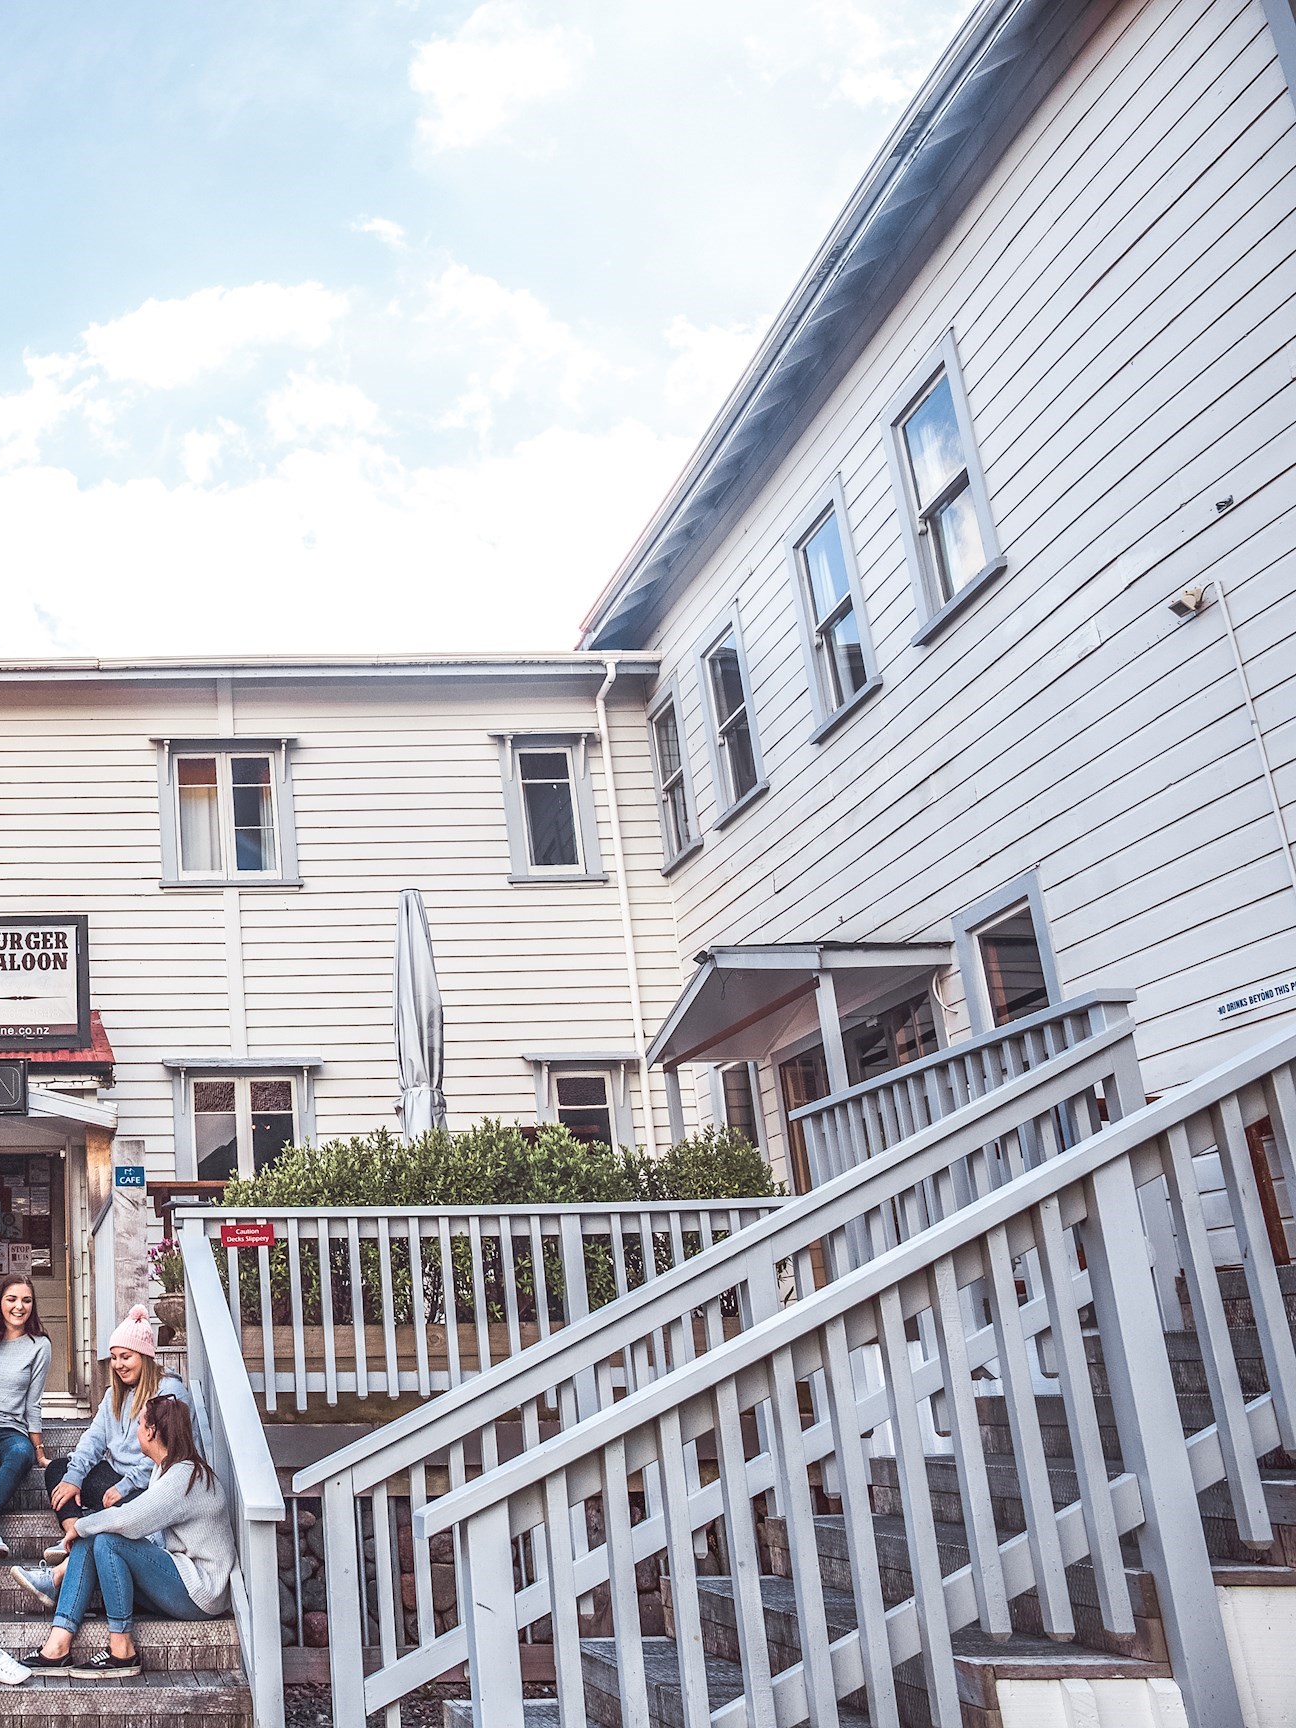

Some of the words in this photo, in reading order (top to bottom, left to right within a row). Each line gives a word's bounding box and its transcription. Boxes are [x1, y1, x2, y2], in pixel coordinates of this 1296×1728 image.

[1217, 1005, 1226, 1015] NO
[1226, 998, 1248, 1012] DRINKS
[1248, 989, 1274, 1005] BEYOND
[1274, 983, 1290, 996] THIS
[119, 1176, 141, 1184] CAFE
[245, 1235, 270, 1243] Slippery
[11, 1245, 30, 1253] STOP
